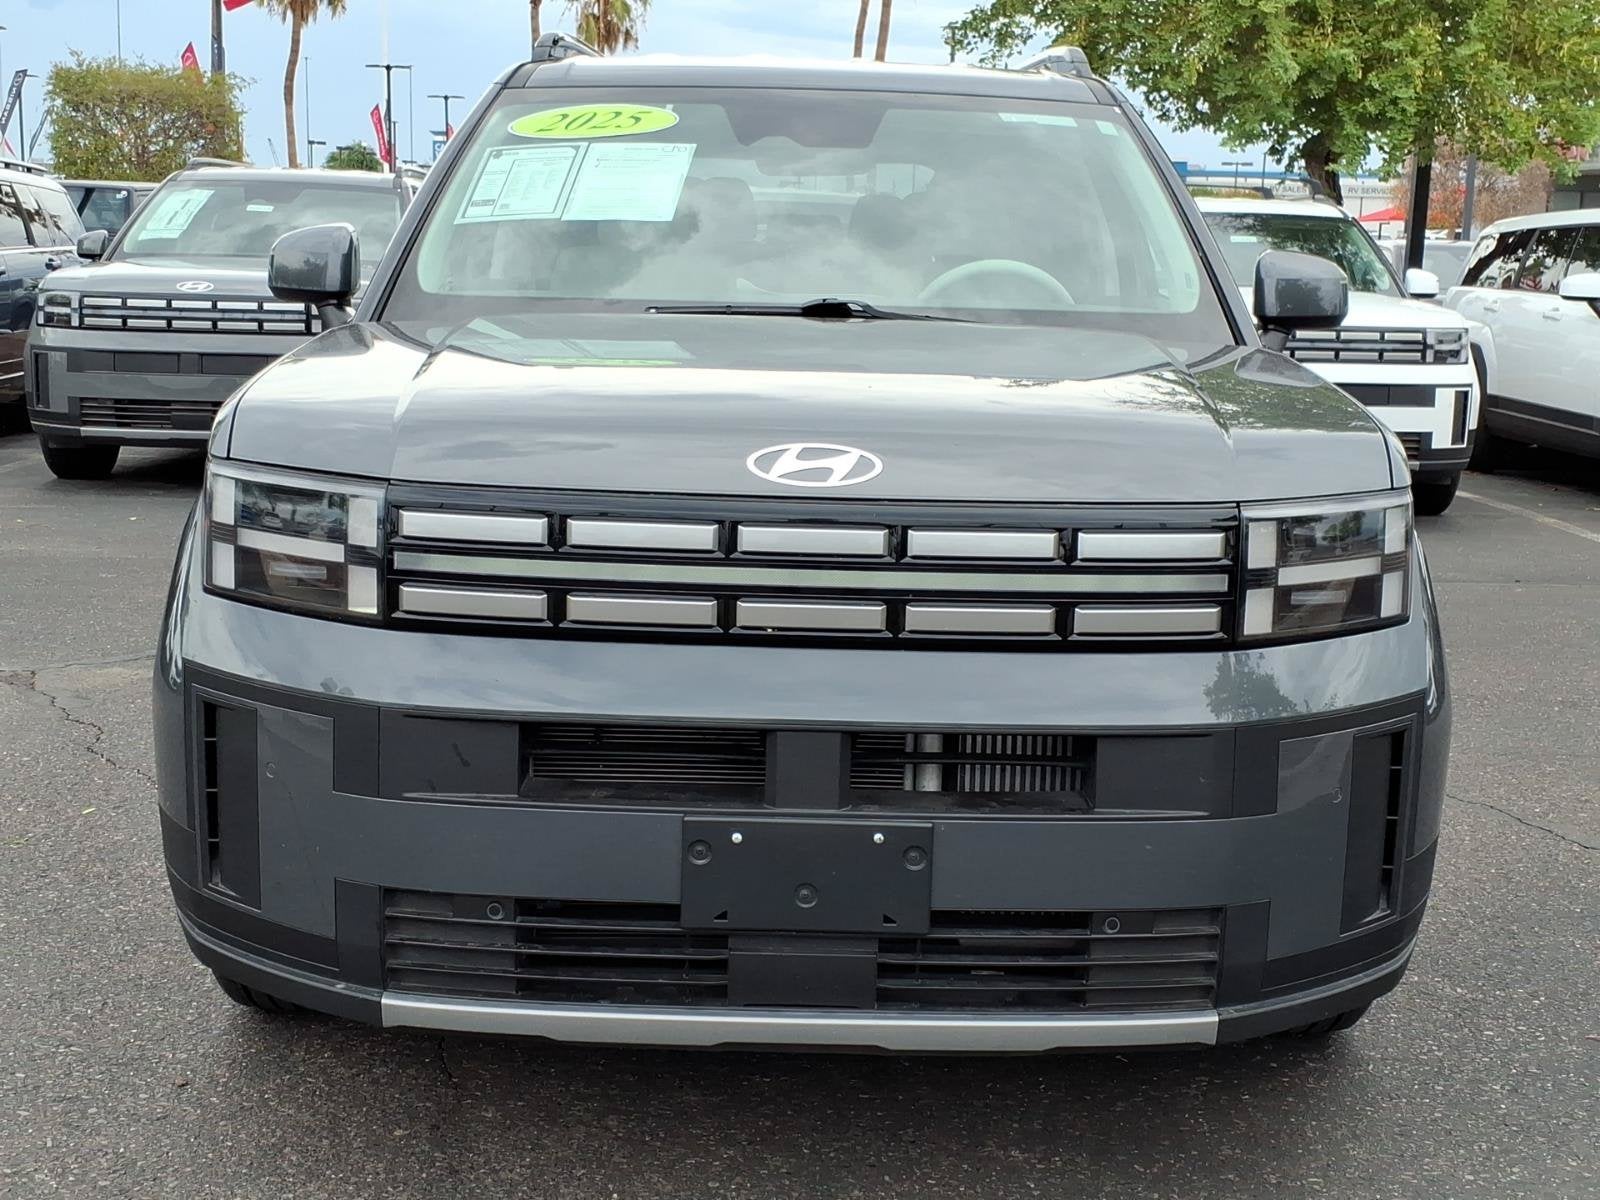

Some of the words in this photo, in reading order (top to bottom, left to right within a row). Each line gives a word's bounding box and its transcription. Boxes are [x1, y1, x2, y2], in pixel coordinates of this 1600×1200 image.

[535, 110, 653, 133] 2025
[1281, 185, 1308, 194] SALES
[1347, 186, 1360, 194] RV
